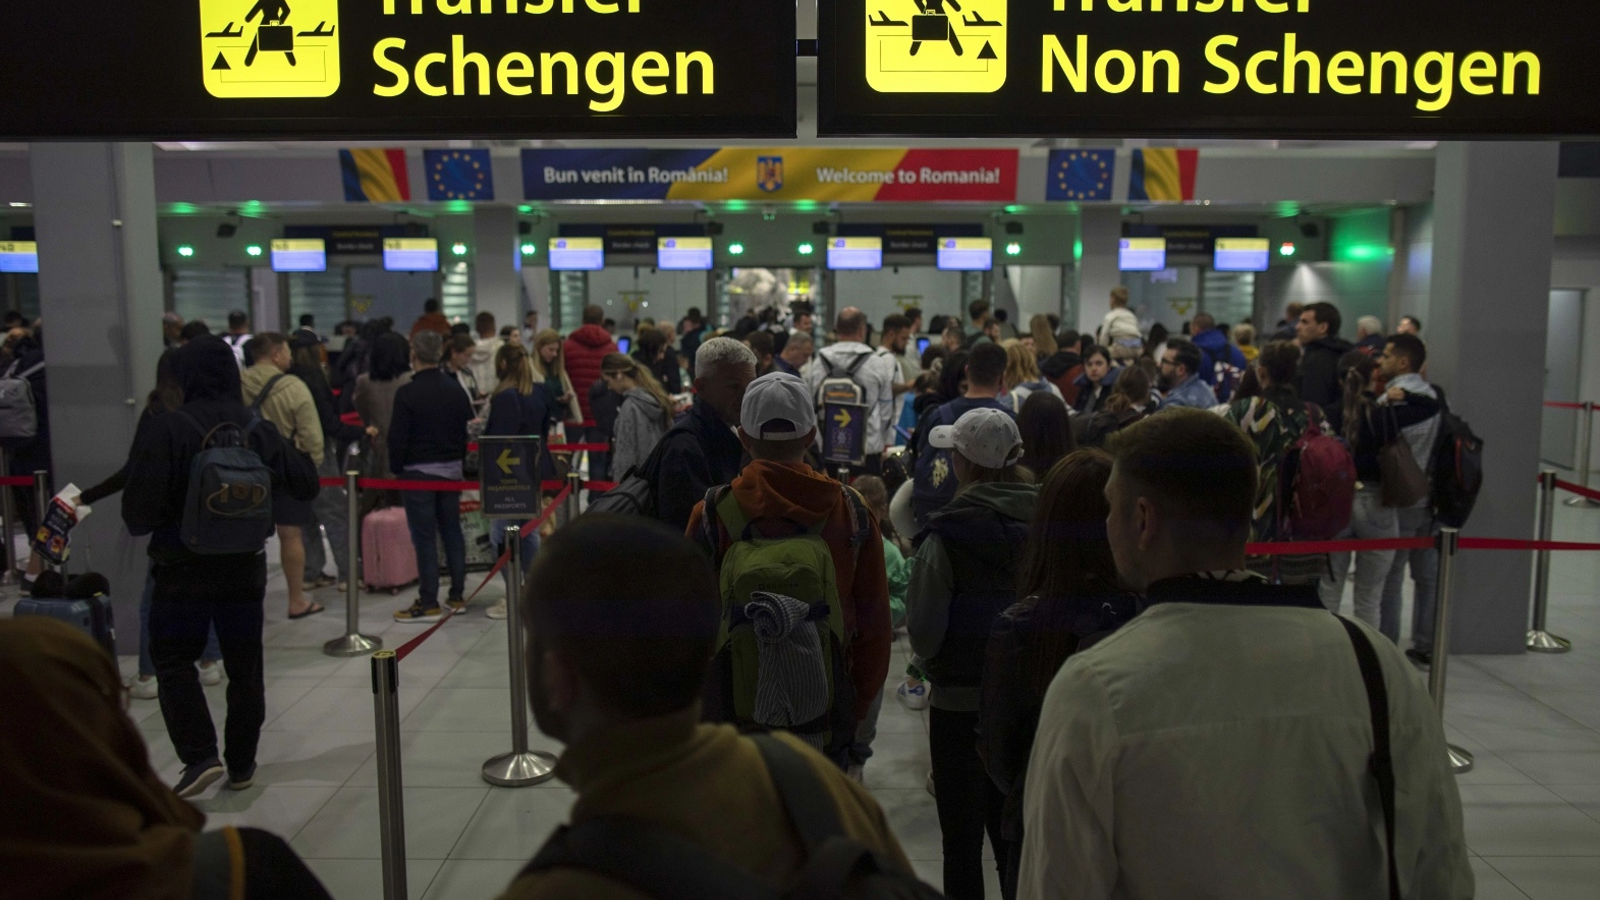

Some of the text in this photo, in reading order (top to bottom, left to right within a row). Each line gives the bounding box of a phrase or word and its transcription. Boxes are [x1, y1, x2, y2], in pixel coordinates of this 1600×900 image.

[372, 34, 714, 112] Schengen
[1041, 33, 1541, 112] Non Schengen
[543, 166, 578, 183] Bun
[581, 166, 626, 183] venit
[647, 166, 728, 183] România!
[816, 167, 1000, 184] Welcome to Romania!
